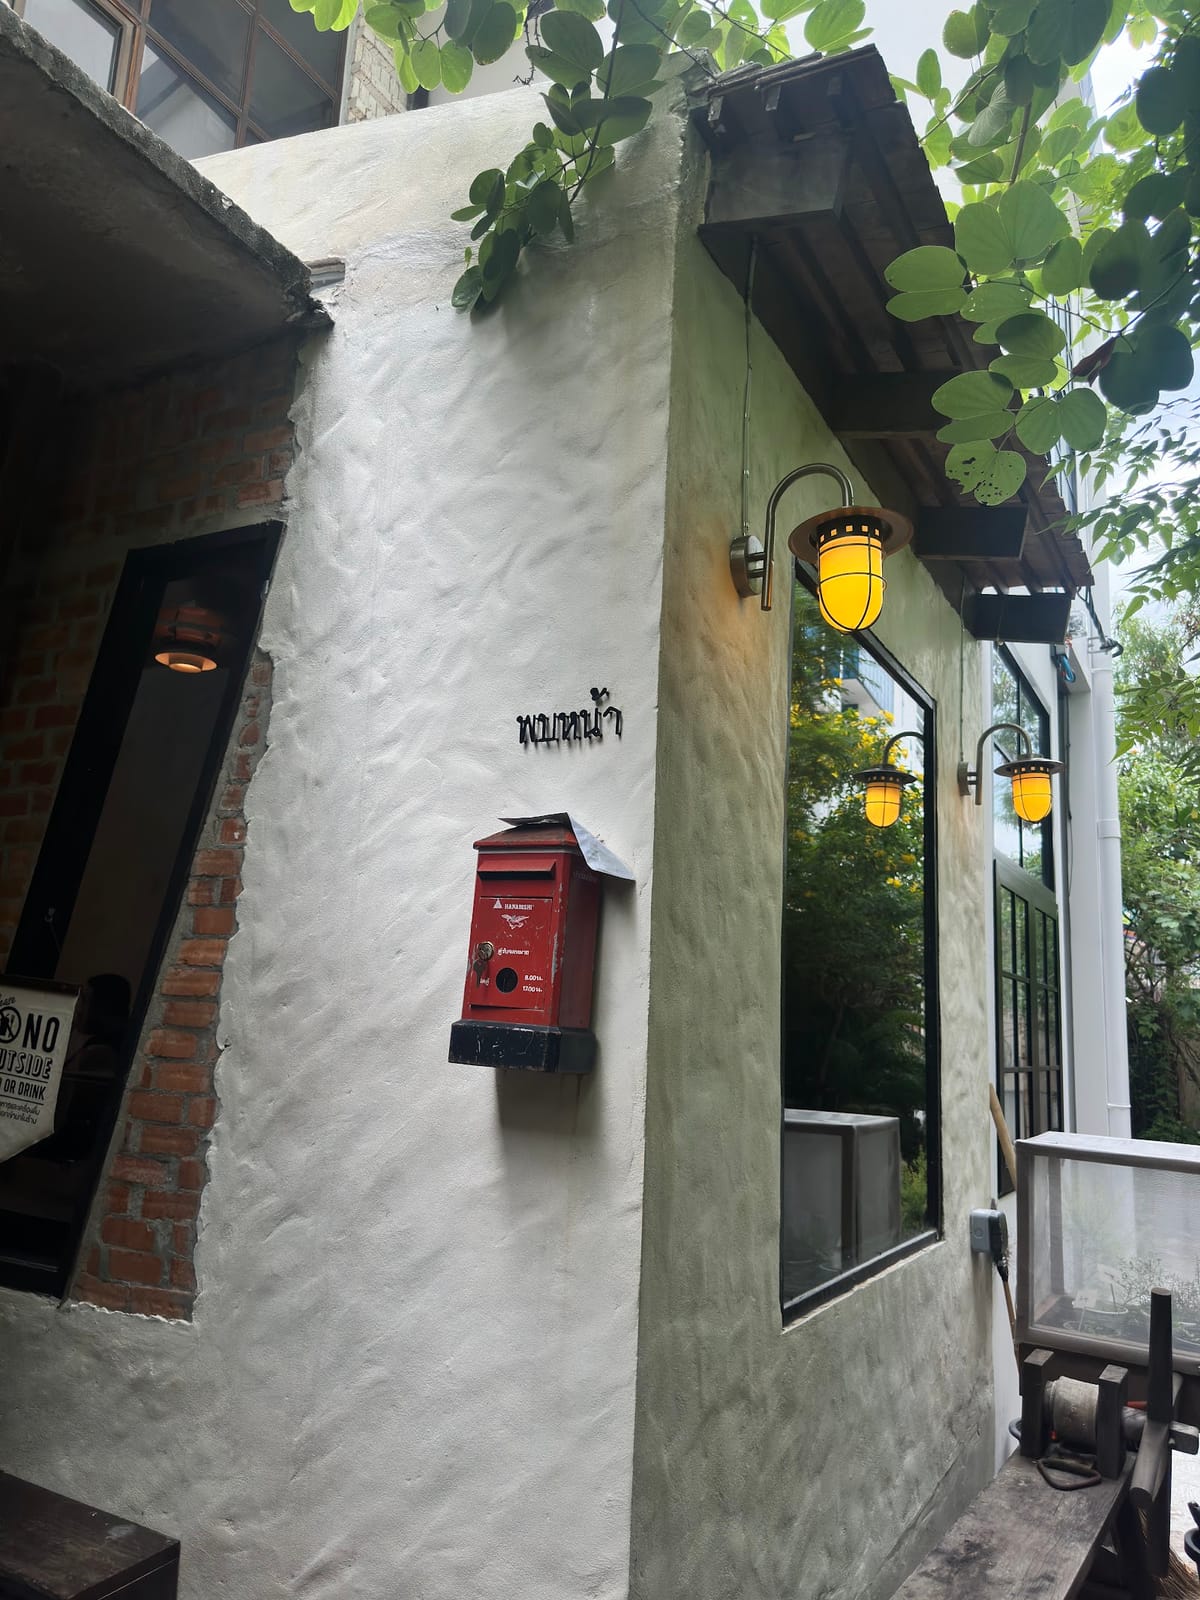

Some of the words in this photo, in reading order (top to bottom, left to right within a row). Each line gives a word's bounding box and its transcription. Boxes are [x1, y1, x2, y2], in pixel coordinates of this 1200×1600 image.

[516, 687, 623, 744] พบหน้า
[22, 1013, 60, 1053] NO
[3, 1078, 17, 1094] OR
[18, 1082, 46, 1101] DRINK
